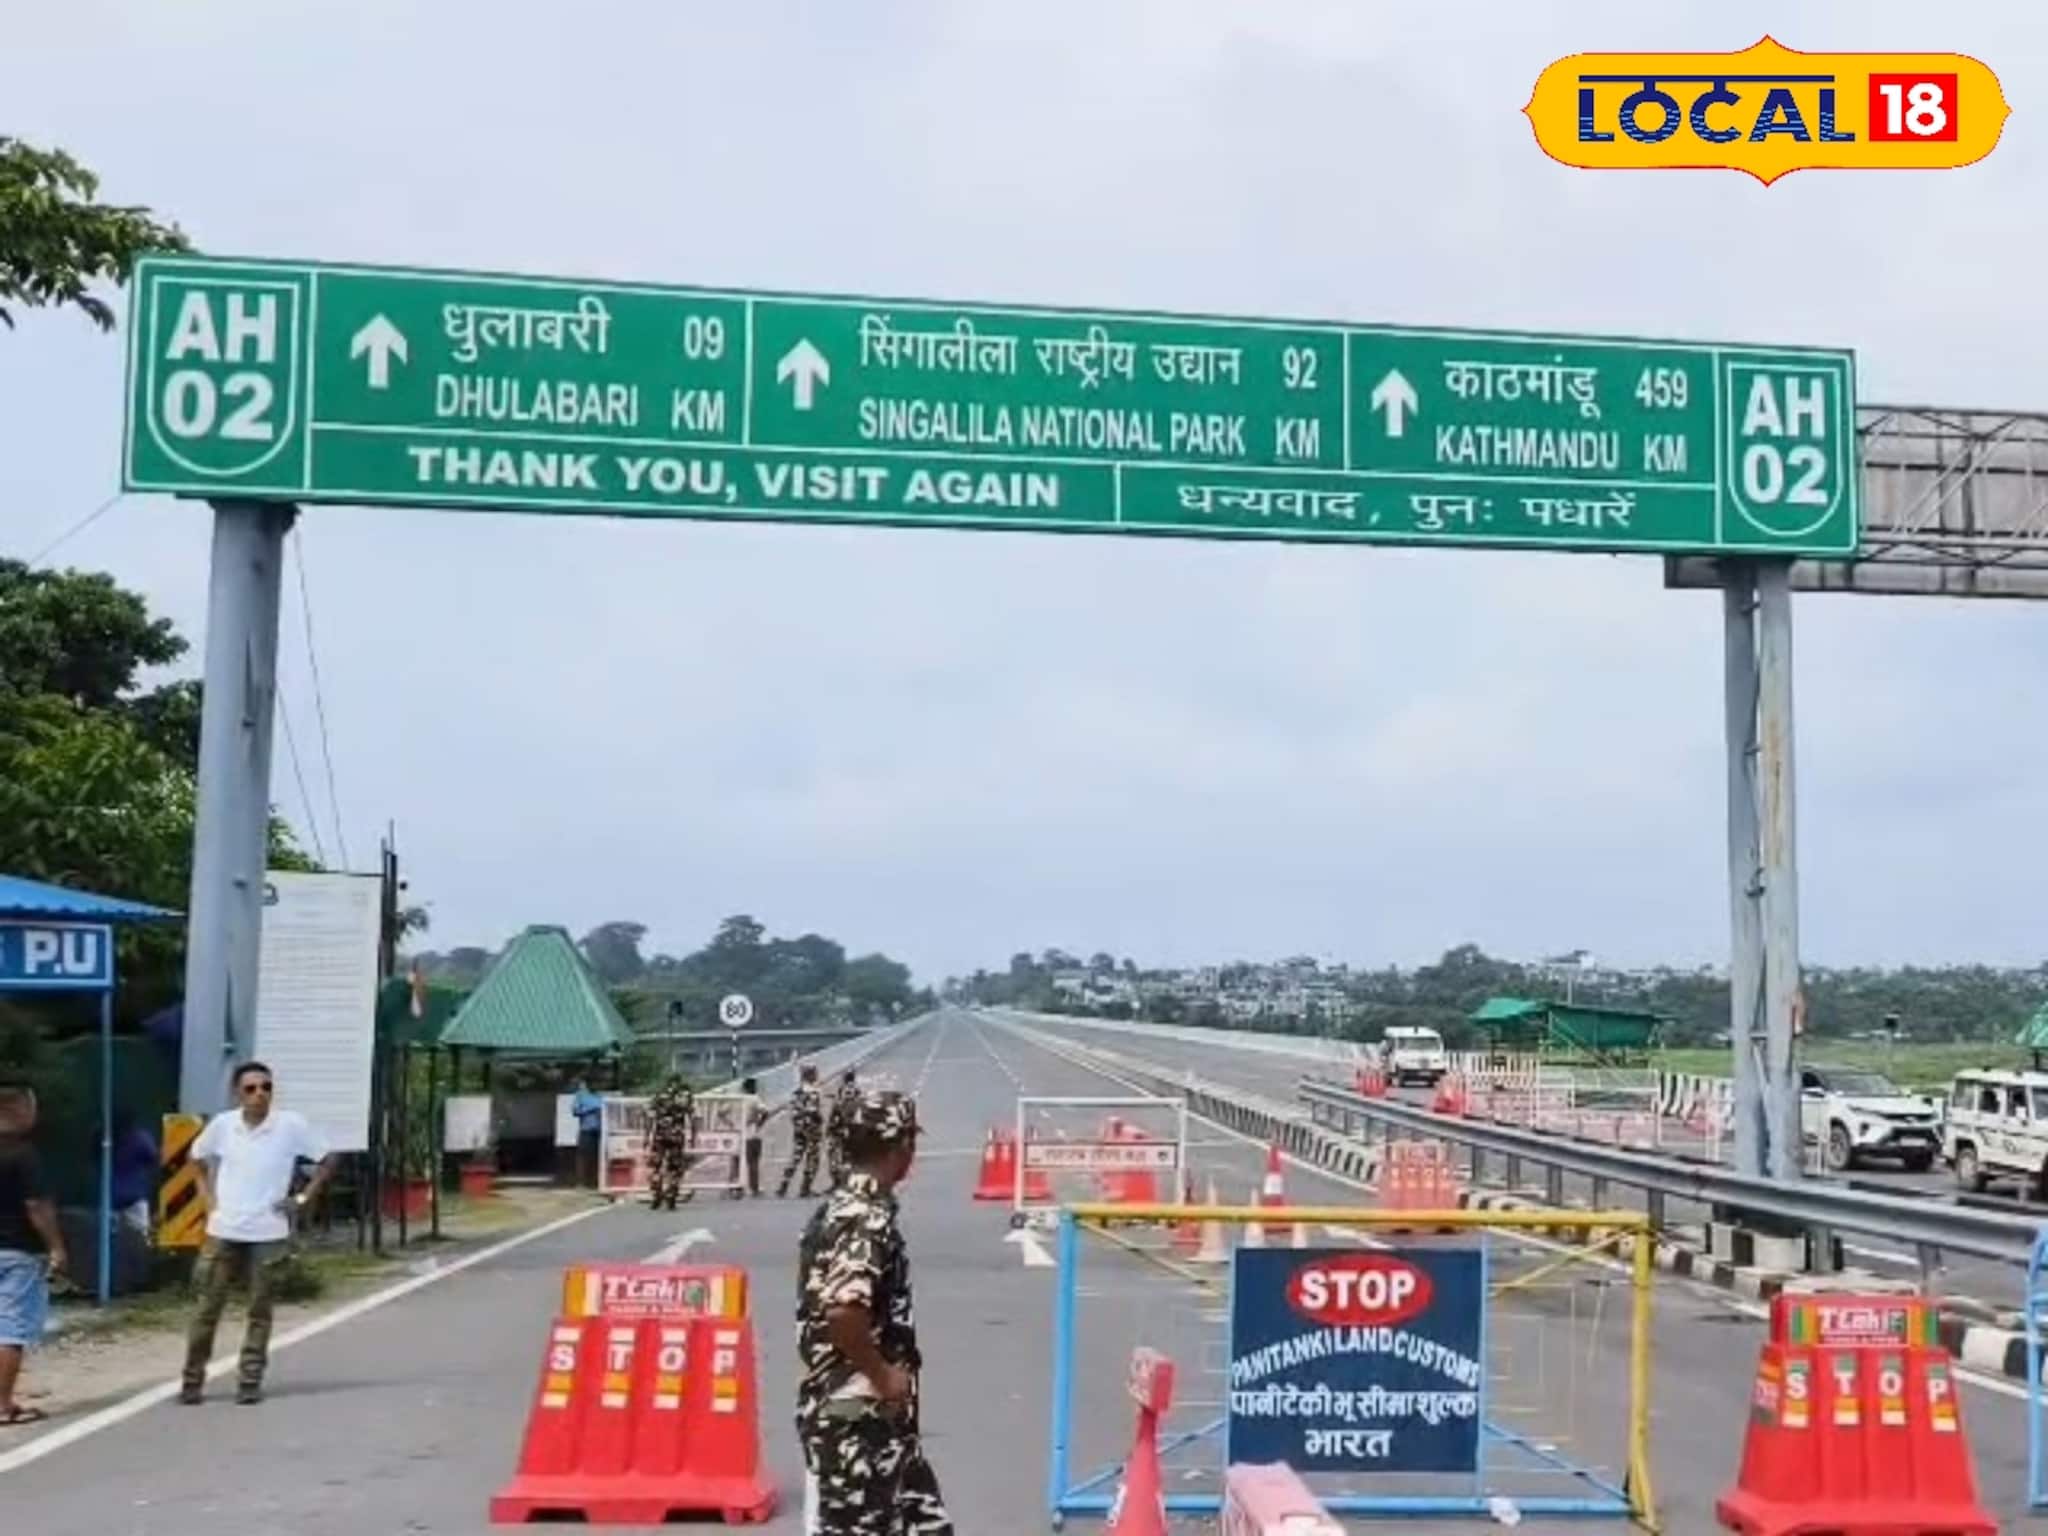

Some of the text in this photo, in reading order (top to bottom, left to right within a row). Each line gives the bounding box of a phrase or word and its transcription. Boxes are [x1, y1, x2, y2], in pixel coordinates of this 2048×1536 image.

[165, 290, 277, 363] AH
[443, 295, 725, 363] धुलाबरी 09
[859, 313, 1318, 389] सिंगालीला राष्ट्रीय उद्यान 92
[163, 369, 274, 441] 02
[436, 373, 725, 433] DHULABARI KM
[1443, 354, 1688, 419] काठमांडू 459
[1741, 374, 1825, 438] AH
[857, 397, 1320, 458] SINGALILA NATIONAL PARK KM
[1436, 424, 1688, 473] KATHMANDU KM
[408, 446, 1058, 508] THANK YOU, VISIT AGAIN
[1743, 444, 1828, 506] 02
[1520, 491, 1636, 528] पधारें
[24, 930, 98, 975] P.U
[1299, 1269, 1416, 1310] STOP
[1232, 1326, 1481, 1389] PANITANKI LAND CUSTOMS
[1304, 1429, 1394, 1458] भारत
